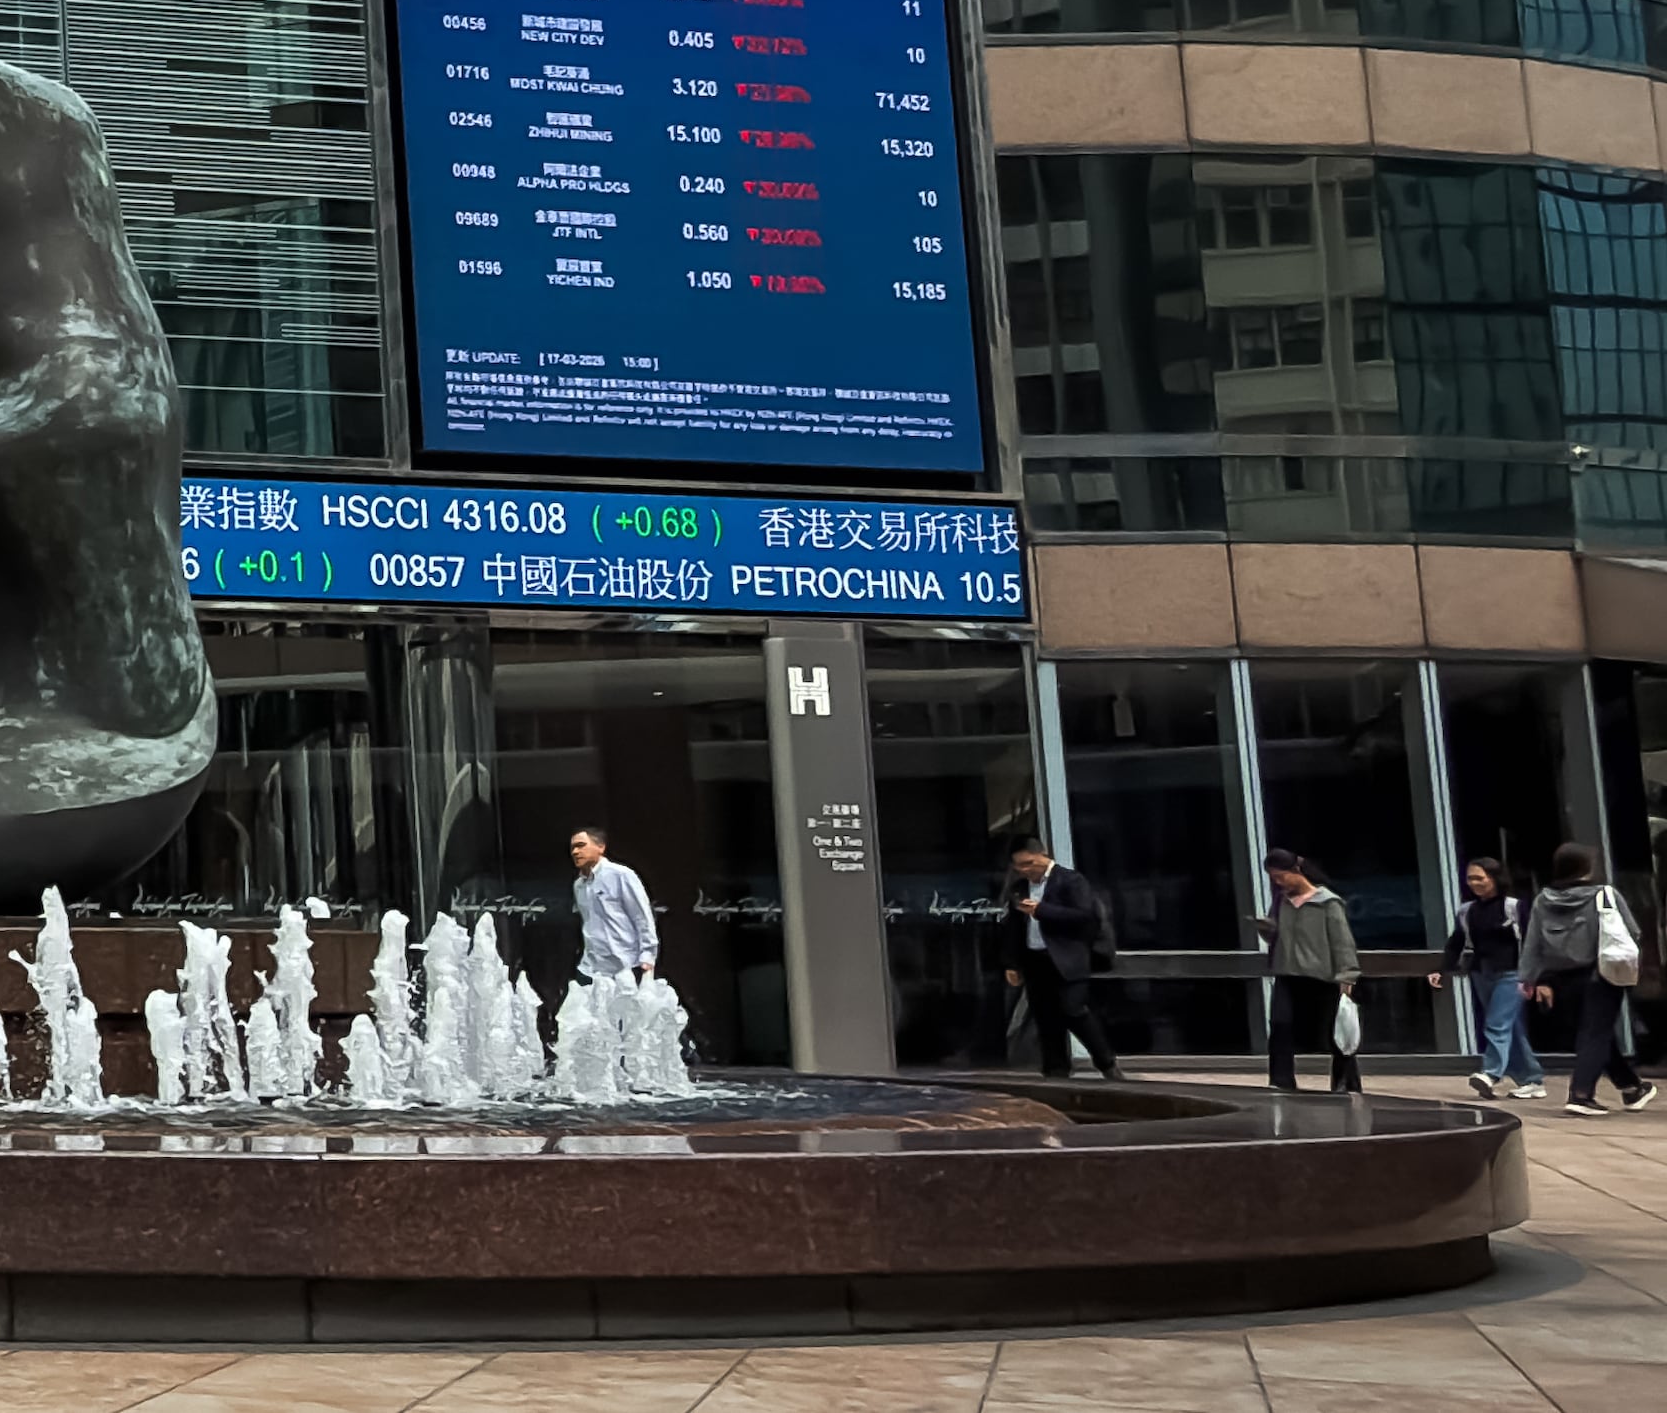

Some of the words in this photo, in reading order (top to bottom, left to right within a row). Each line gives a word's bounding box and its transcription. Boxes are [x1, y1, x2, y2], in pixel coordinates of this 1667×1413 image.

[902, 0, 921, 17] 11
[907, 47, 926, 64] 10
[446, 63, 490, 81] 01716
[672, 77, 718, 97] 3.120
[874, 91, 931, 112] 71,452
[666, 124, 722, 144] 15.100
[880, 138, 934, 158] 15,320
[679, 175, 726, 194] 0.240
[918, 190, 938, 208] 10
[682, 222, 729, 242] 0.560
[912, 236, 943, 254] 105
[686, 270, 732, 290] 1.050
[892, 281, 947, 301] 15,185
[323, 495, 428, 529] HSCCI
[443, 499, 566, 534] 4316.08
[616, 507, 697, 538] +0.68
[759, 507, 1019, 554] 香港交易所科技
[239, 550, 302, 581] +0.1
[370, 554, 464, 587] 00857
[483, 553, 713, 600] 中國石油股份
[731, 565, 944, 600] PETROCHINA
[960, 572, 1020, 603] 10.5
